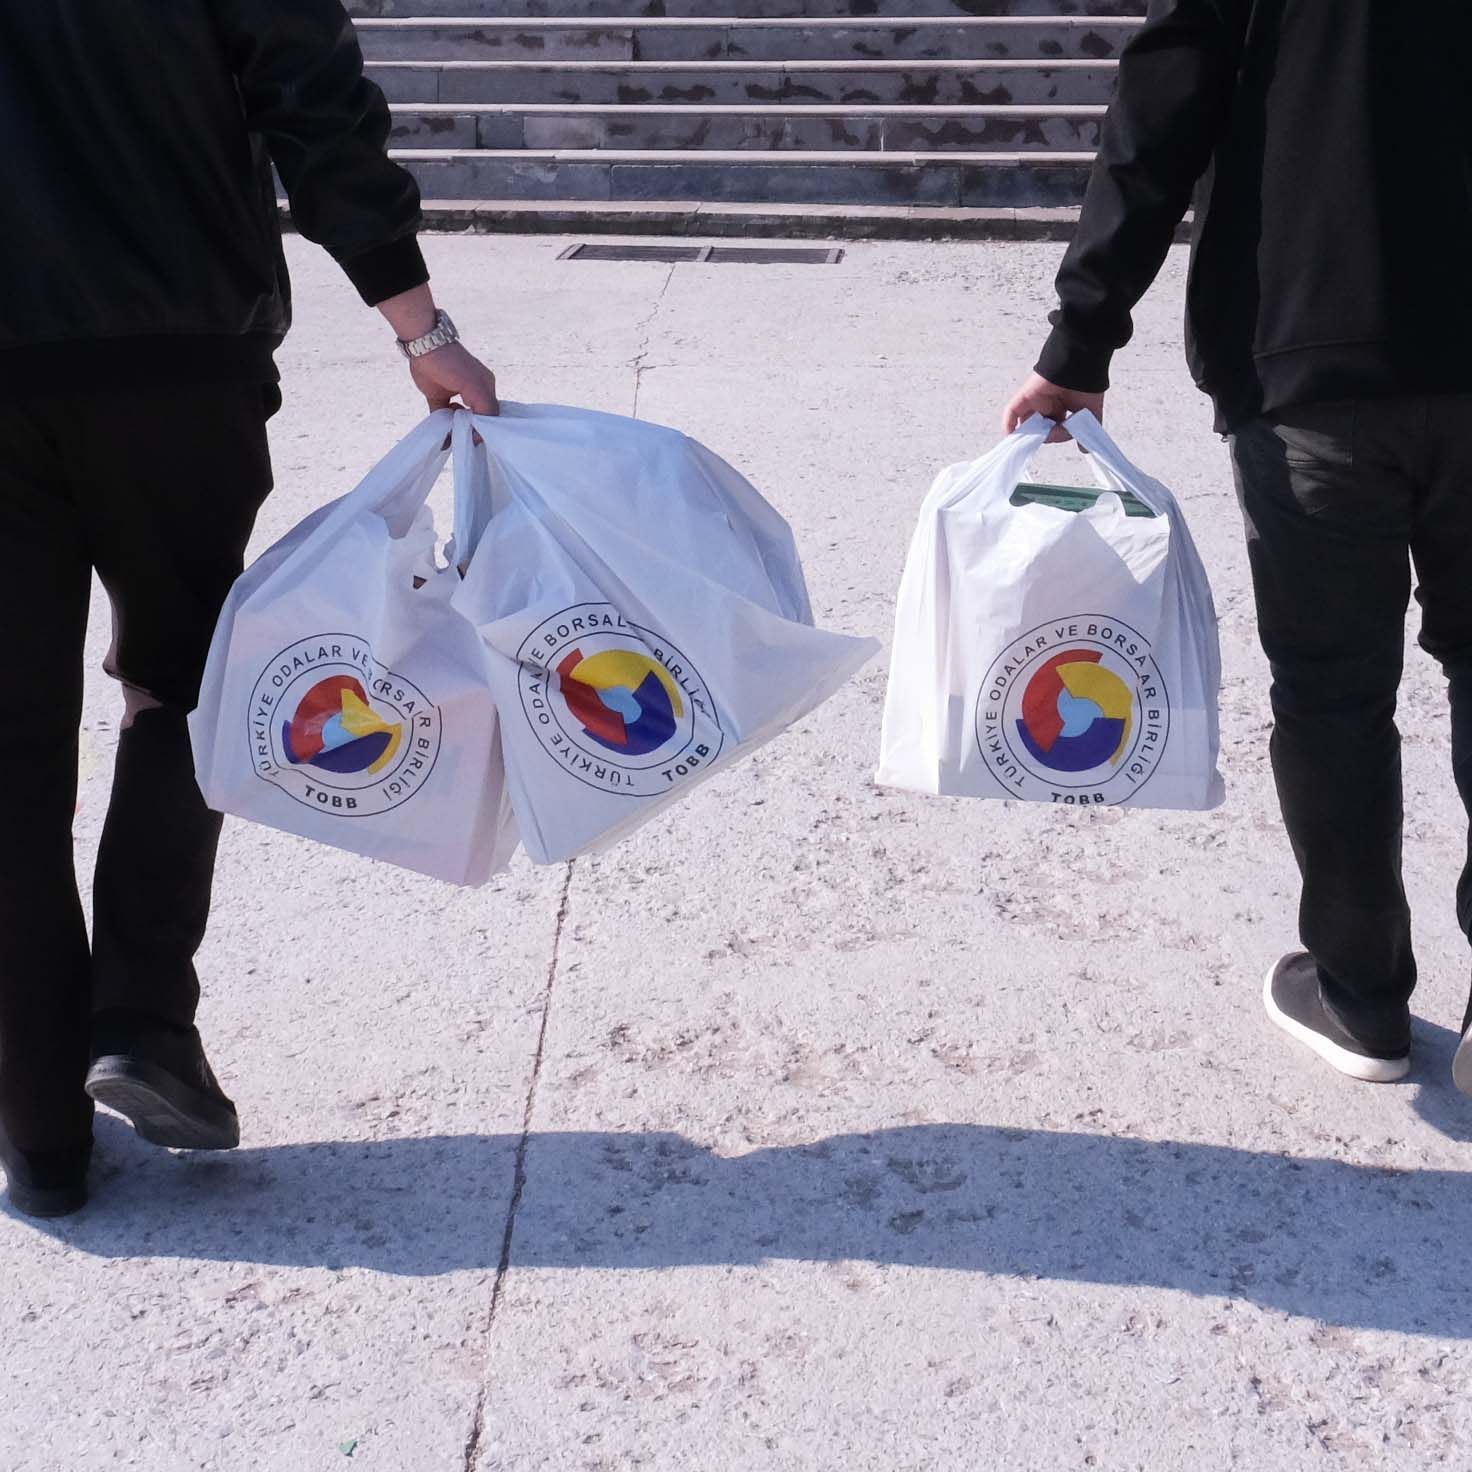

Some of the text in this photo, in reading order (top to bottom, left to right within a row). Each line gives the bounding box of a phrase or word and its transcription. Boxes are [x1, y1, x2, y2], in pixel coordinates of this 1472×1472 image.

[544, 613, 628, 647] BORSAL
[272, 645, 342, 688] ODALAR
[352, 648, 369, 668] VE
[383, 738, 431, 801] BİRLİĞİ
[985, 624, 1163, 788] TÜRKİYE ODALAR VE BORSAAR BİRLİĞİ
[550, 734, 635, 787] TÜRKİYE
[661, 743, 710, 782] TOBB
[304, 785, 358, 809] TOBB
[1050, 792, 1105, 805] TOBB
